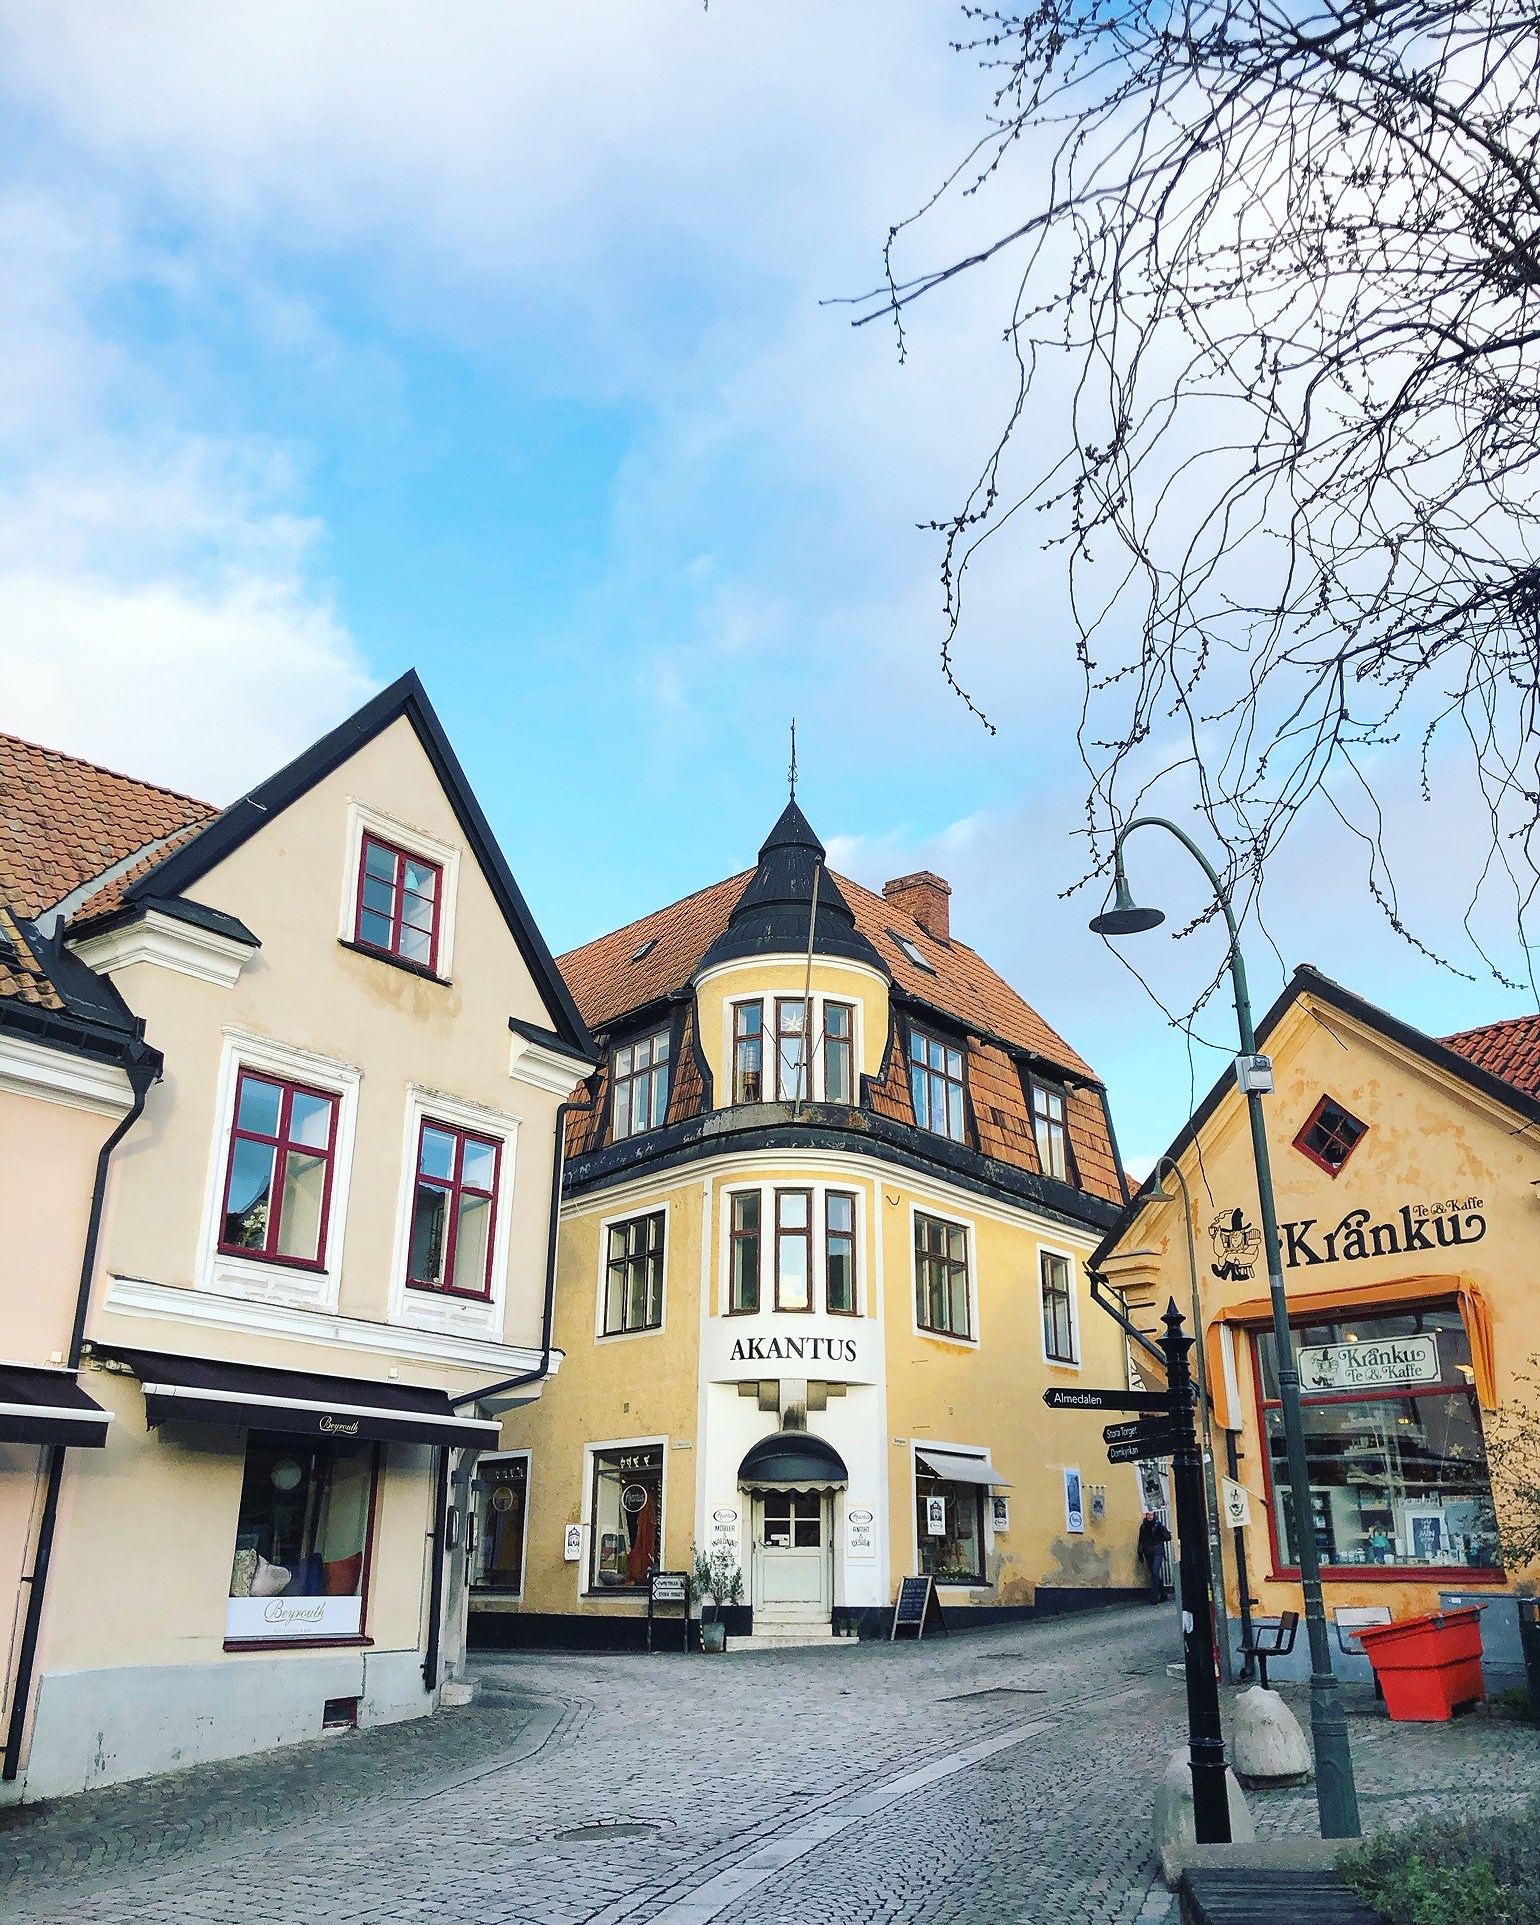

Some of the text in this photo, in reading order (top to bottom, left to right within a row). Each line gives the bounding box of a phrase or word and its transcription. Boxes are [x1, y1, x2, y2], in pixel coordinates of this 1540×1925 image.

[1412, 1196, 1484, 1217] Te & Kaffe
[1277, 1205, 1487, 1269] Kränku
[729, 1336, 857, 1362] AKANTUS
[1338, 1344, 1426, 1369] Kränku
[1345, 1369, 1363, 1383] Te
[1382, 1363, 1423, 1379] Kaffe
[1053, 1392, 1102, 1405] Almedalen
[319, 1415, 359, 1435] Beyrouth
[1106, 1426, 1138, 1439] Stora Torget
[1110, 1445, 1139, 1458] Domkyrkan
[264, 1598, 327, 1627] Beyrouth
